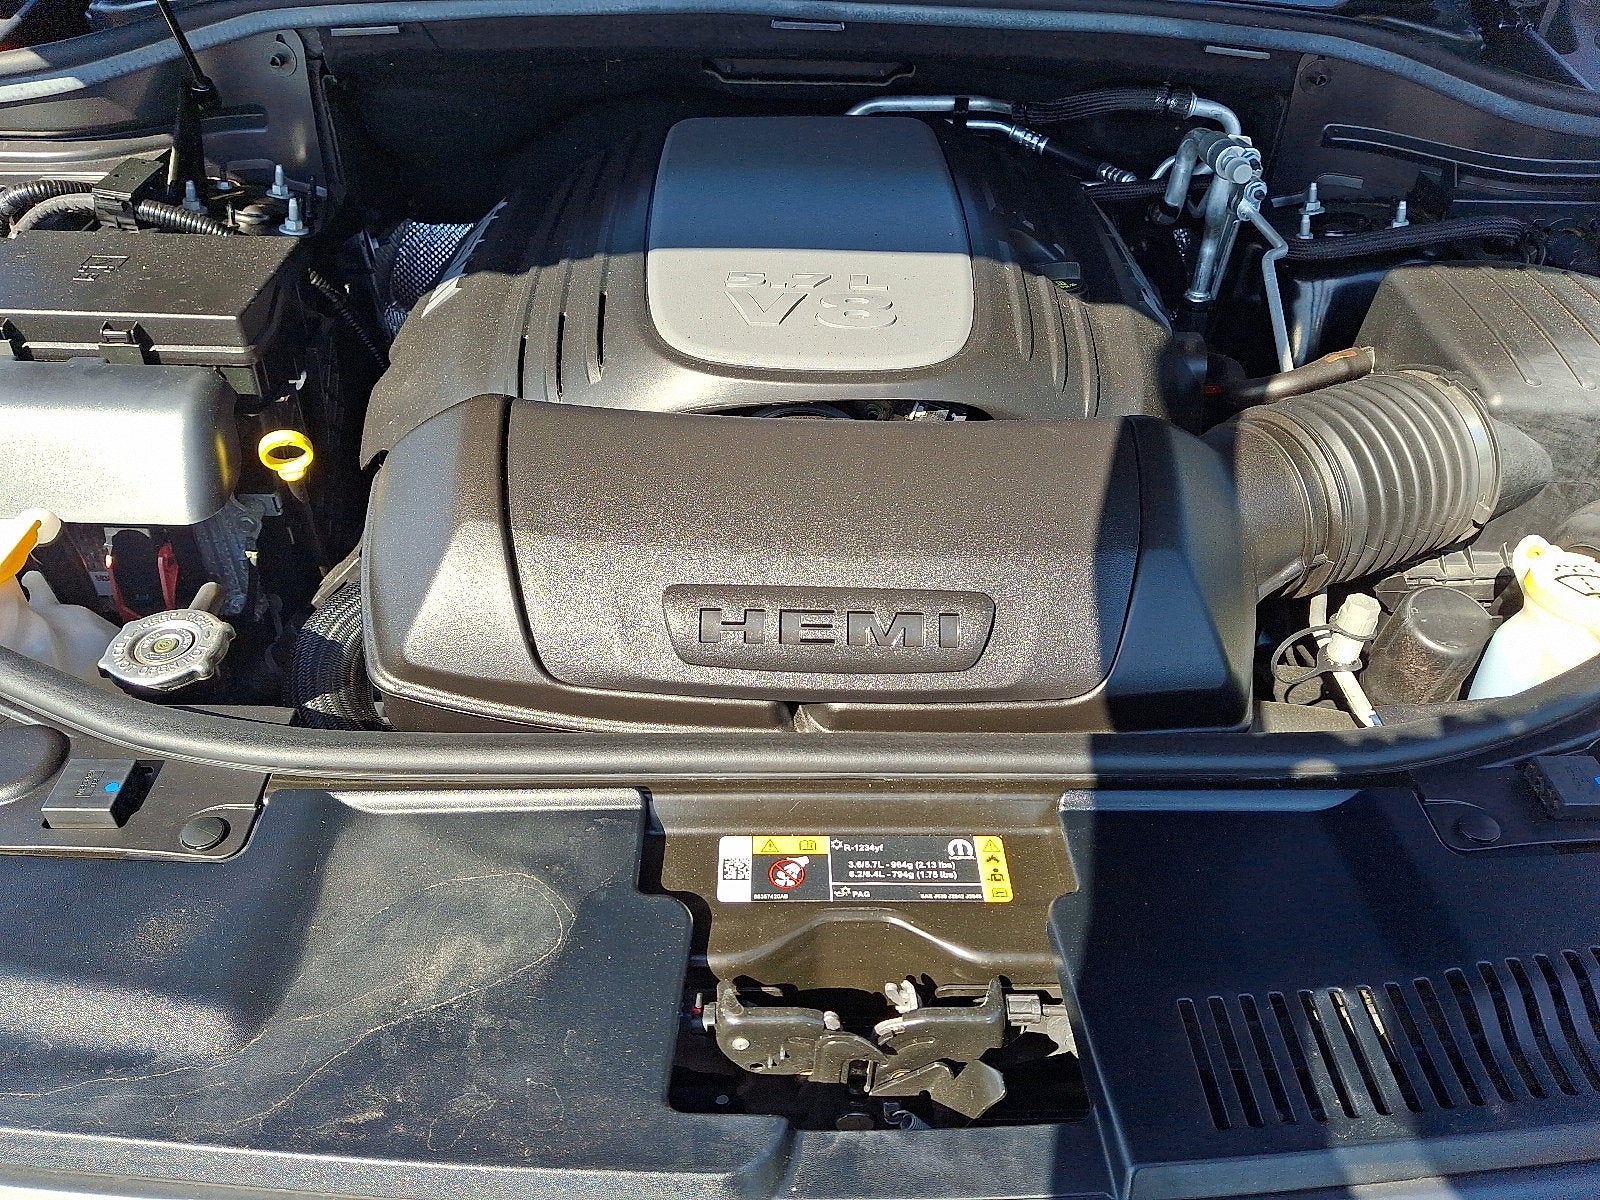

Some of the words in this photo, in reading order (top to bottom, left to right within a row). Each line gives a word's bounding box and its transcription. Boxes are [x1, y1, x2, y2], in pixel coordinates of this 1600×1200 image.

[723, 291, 898, 329] V8
[699, 607, 961, 649] HEMI
[843, 844, 884, 853] R-1234yf
